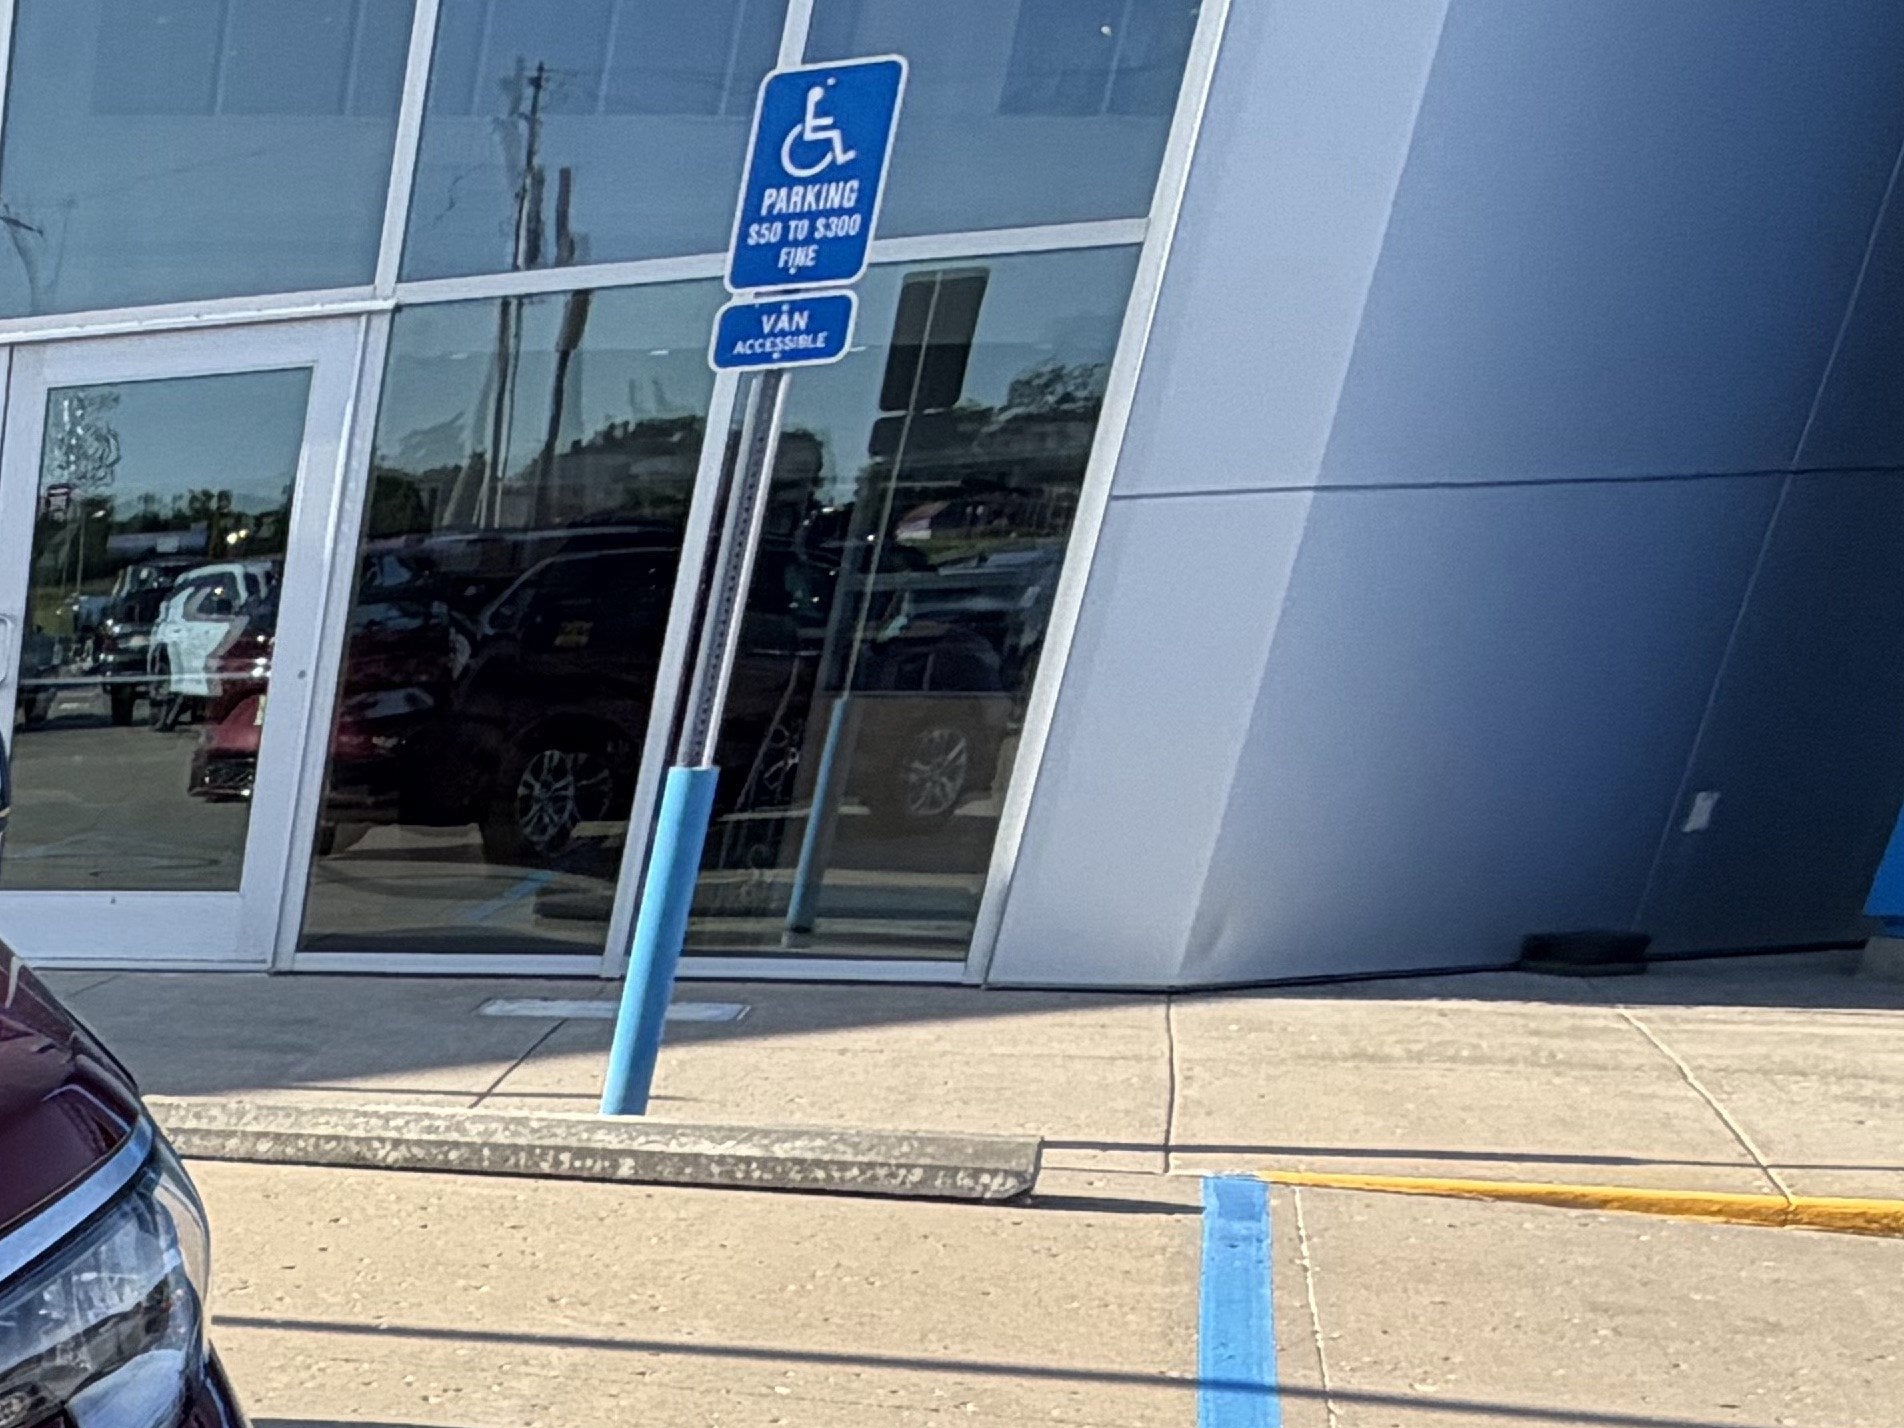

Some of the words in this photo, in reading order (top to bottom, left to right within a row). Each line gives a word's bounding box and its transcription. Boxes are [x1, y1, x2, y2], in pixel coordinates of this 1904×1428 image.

[760, 179, 860, 216] PARKING
[746, 221, 783, 246] $50
[788, 218, 810, 242] TO
[814, 213, 863, 240] $300
[777, 244, 820, 269] FINE
[761, 309, 810, 334] VAN
[732, 331, 828, 356] ACCESSIBLE
